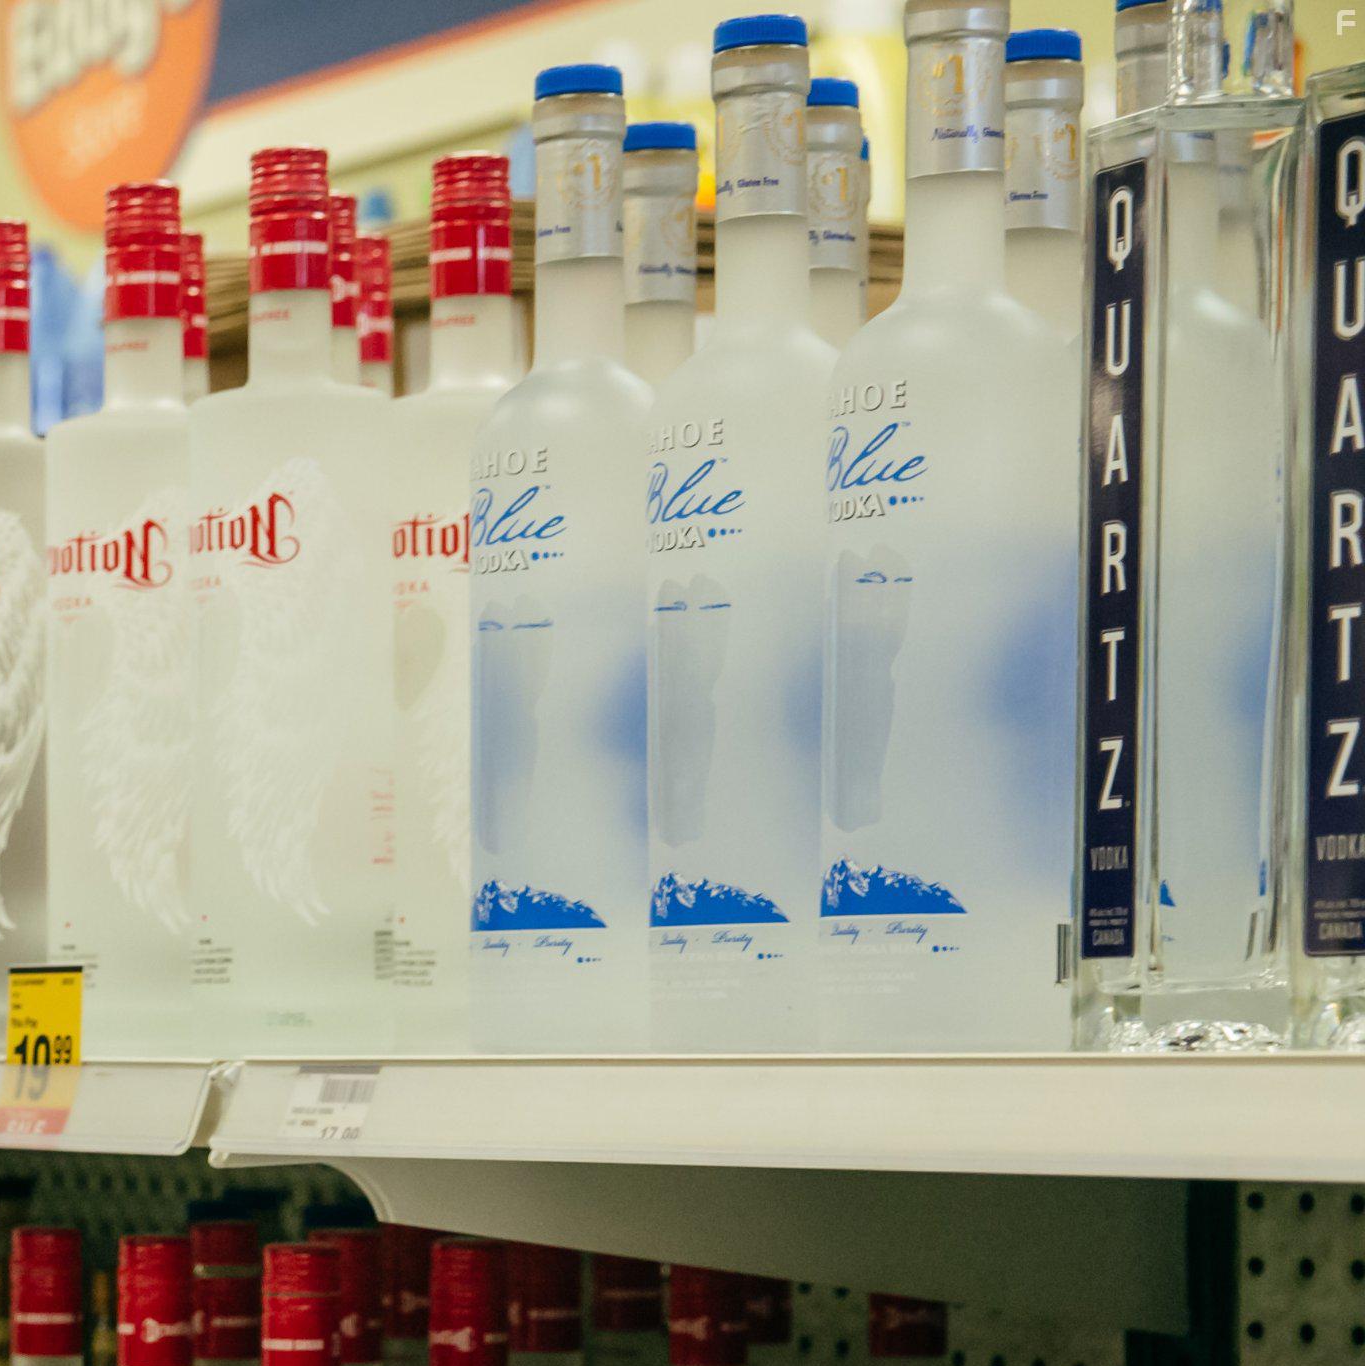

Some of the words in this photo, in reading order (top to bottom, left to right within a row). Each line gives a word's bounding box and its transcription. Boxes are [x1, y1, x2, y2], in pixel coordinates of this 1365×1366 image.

[827, 423, 929, 492] Blue
[1324, 136, 1365, 799] QUARTZ
[472, 486, 567, 547] Blue
[647, 459, 746, 524] Blue
[1098, 185, 1133, 812] QUARTZ
[473, 550, 529, 575] ODKA
